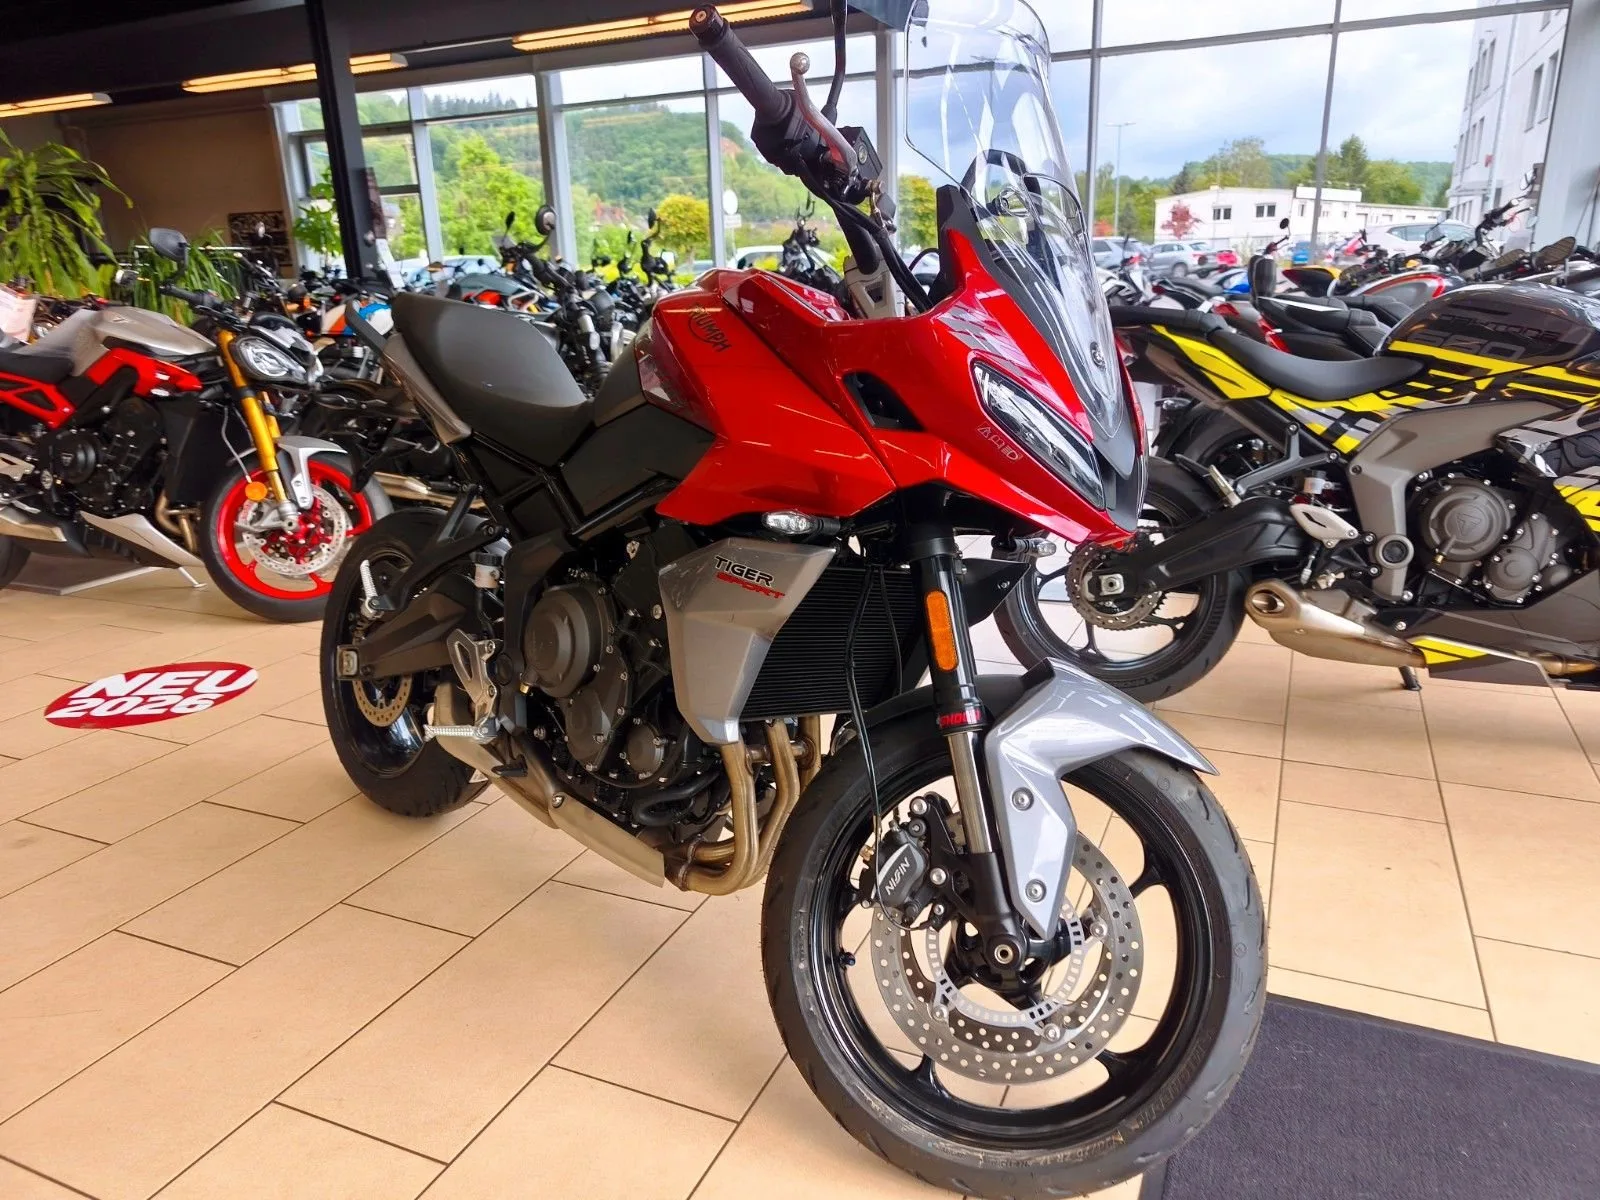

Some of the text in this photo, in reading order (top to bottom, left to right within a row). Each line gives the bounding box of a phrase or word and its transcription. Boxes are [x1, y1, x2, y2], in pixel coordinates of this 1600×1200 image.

[715, 555, 775, 587] TIGER
[68, 668, 259, 699] NEU
[44, 693, 225, 719] 2026
